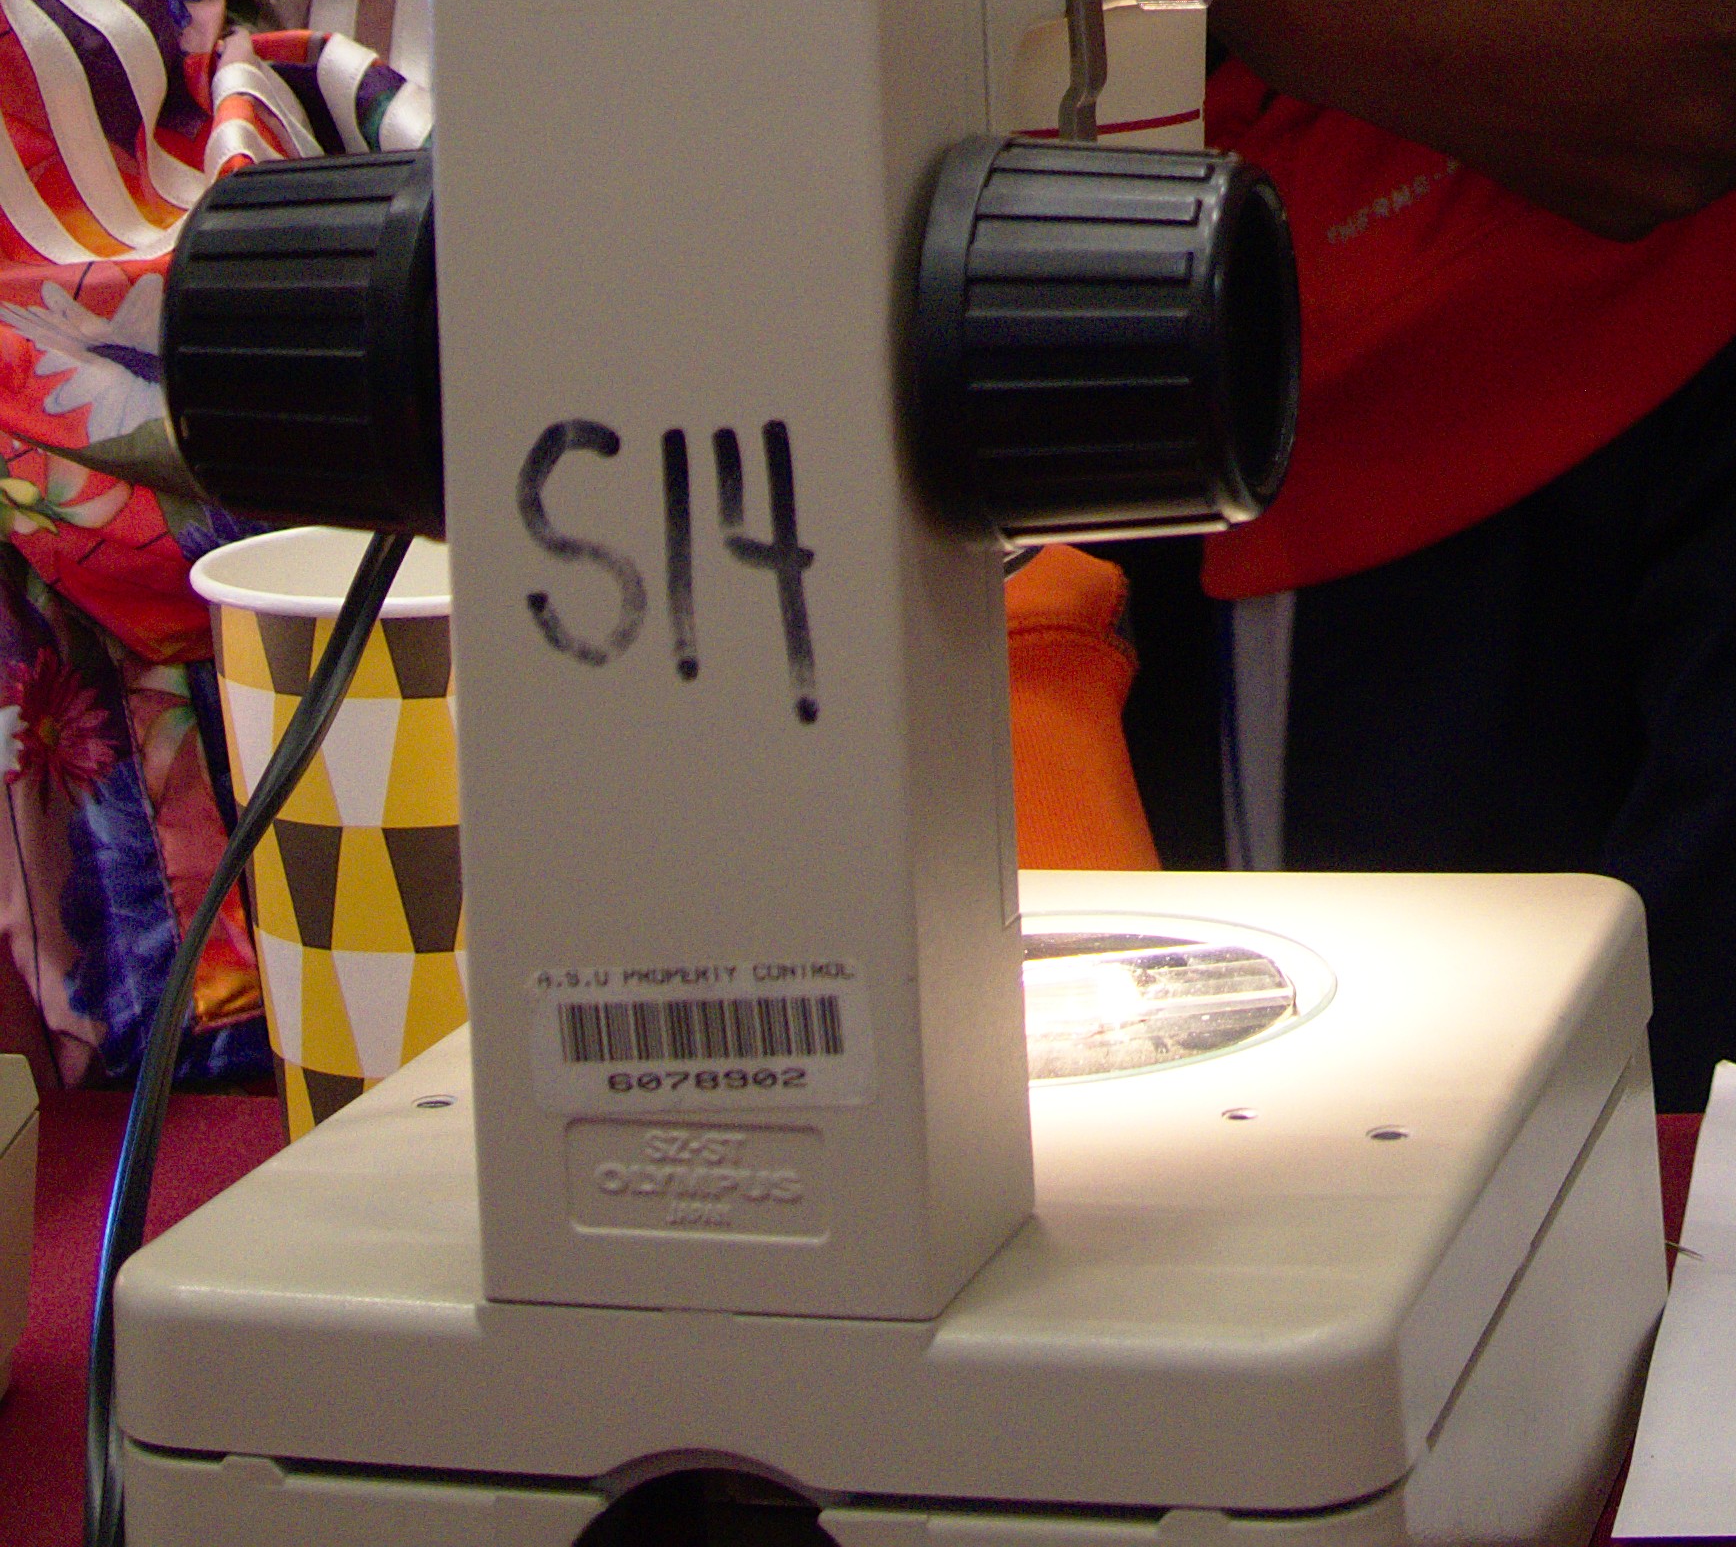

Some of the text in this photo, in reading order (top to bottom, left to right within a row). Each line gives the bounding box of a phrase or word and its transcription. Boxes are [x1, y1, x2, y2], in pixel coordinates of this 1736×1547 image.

[516, 418, 819, 724] S14
[622, 962, 737, 986] PROPERTY
[752, 961, 856, 983] CONTROL
[608, 1067, 807, 1093] 6078902
[595, 1161, 805, 1202] OLYMPUS
